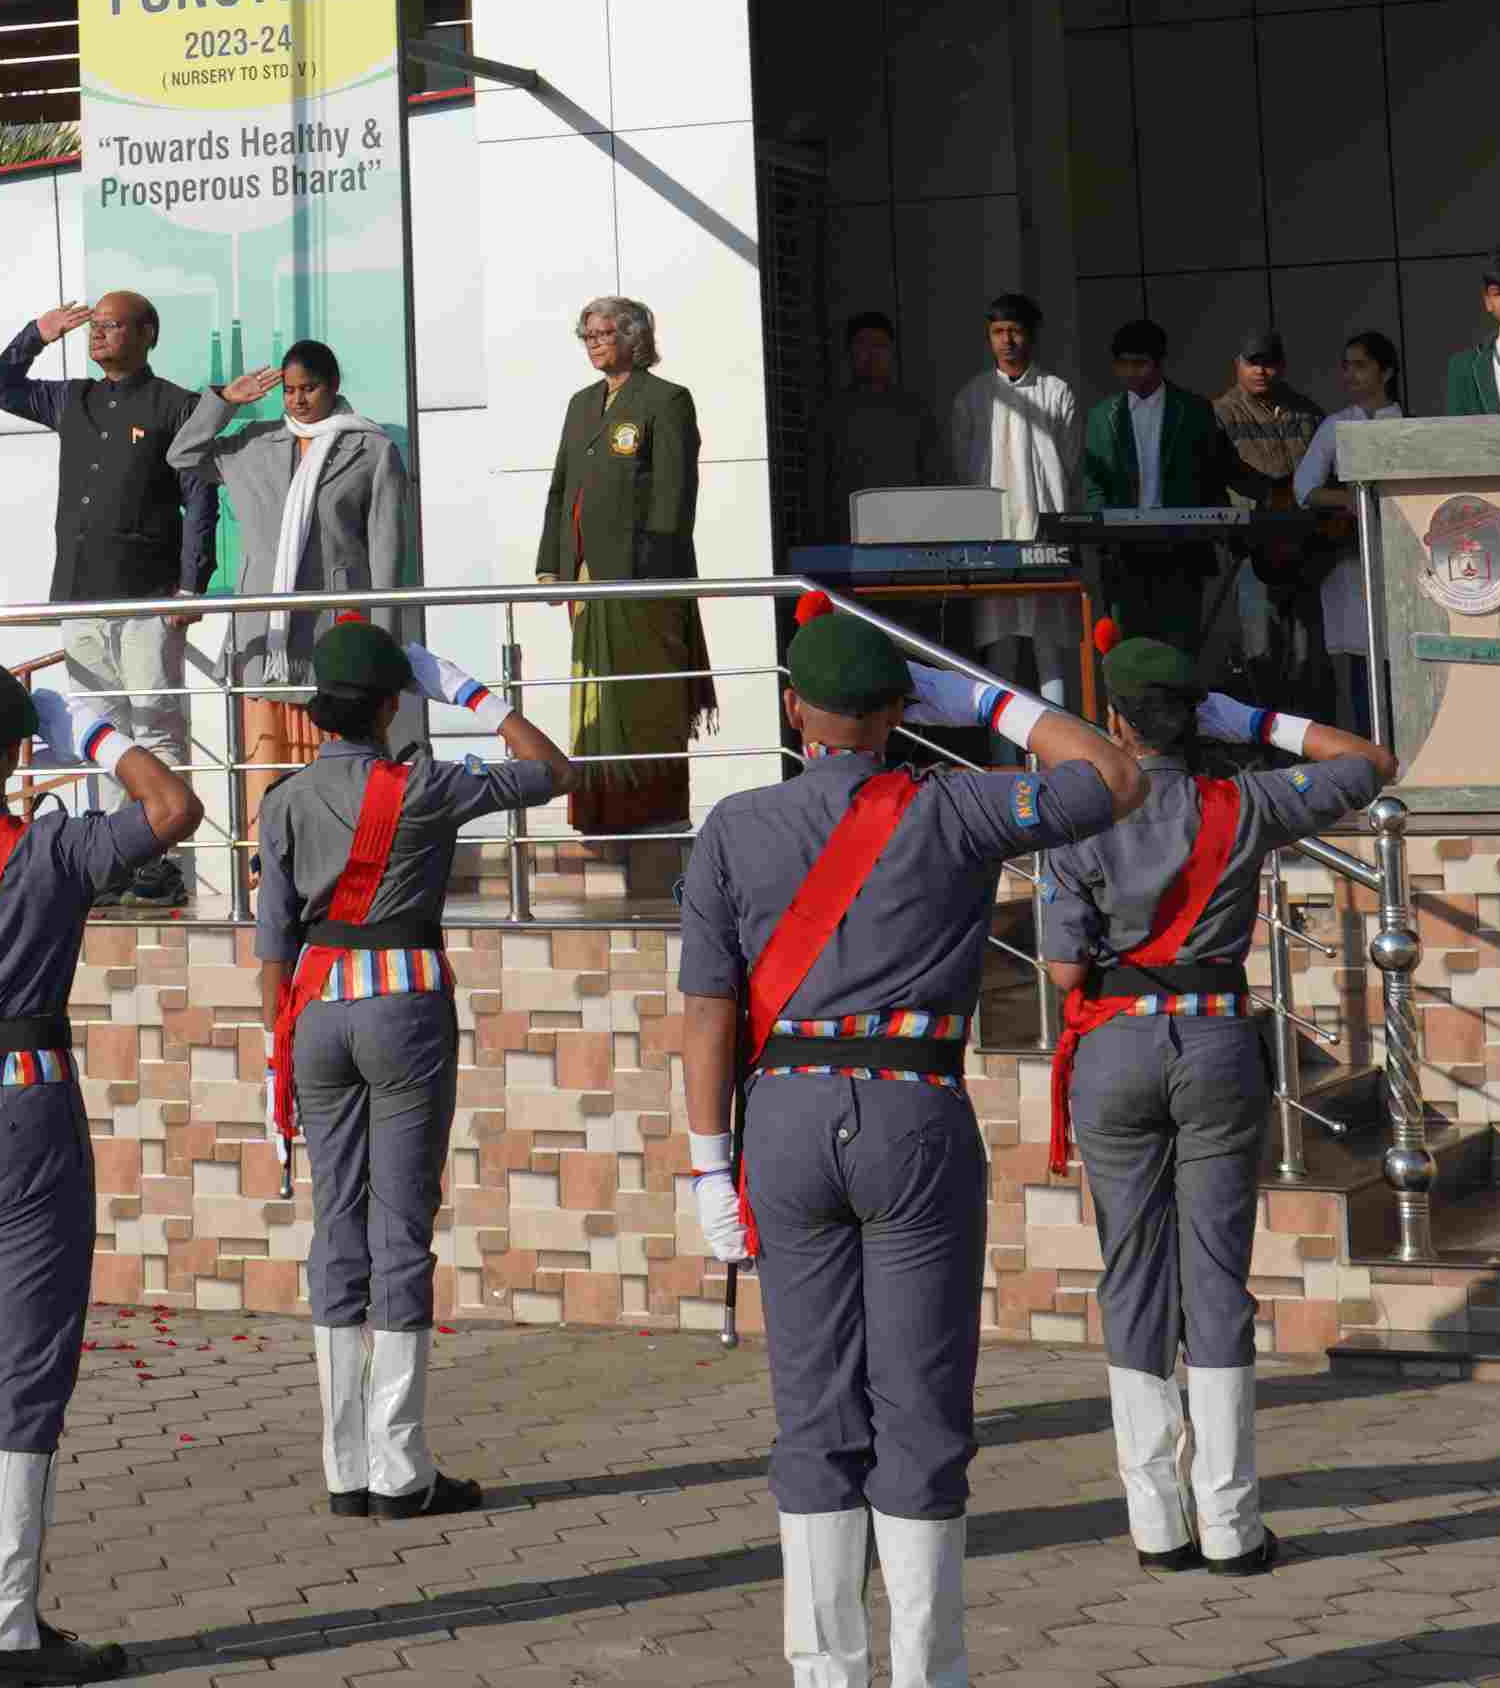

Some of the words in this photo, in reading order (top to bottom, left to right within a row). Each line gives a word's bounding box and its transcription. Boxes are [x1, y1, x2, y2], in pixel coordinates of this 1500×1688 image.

[184, 24, 294, 60] 2023-24
[240, 66, 258, 81] TO
[241, 124, 349, 159] Healthy
[362, 118, 382, 149] &
[101, 172, 261, 210] Prosperous
